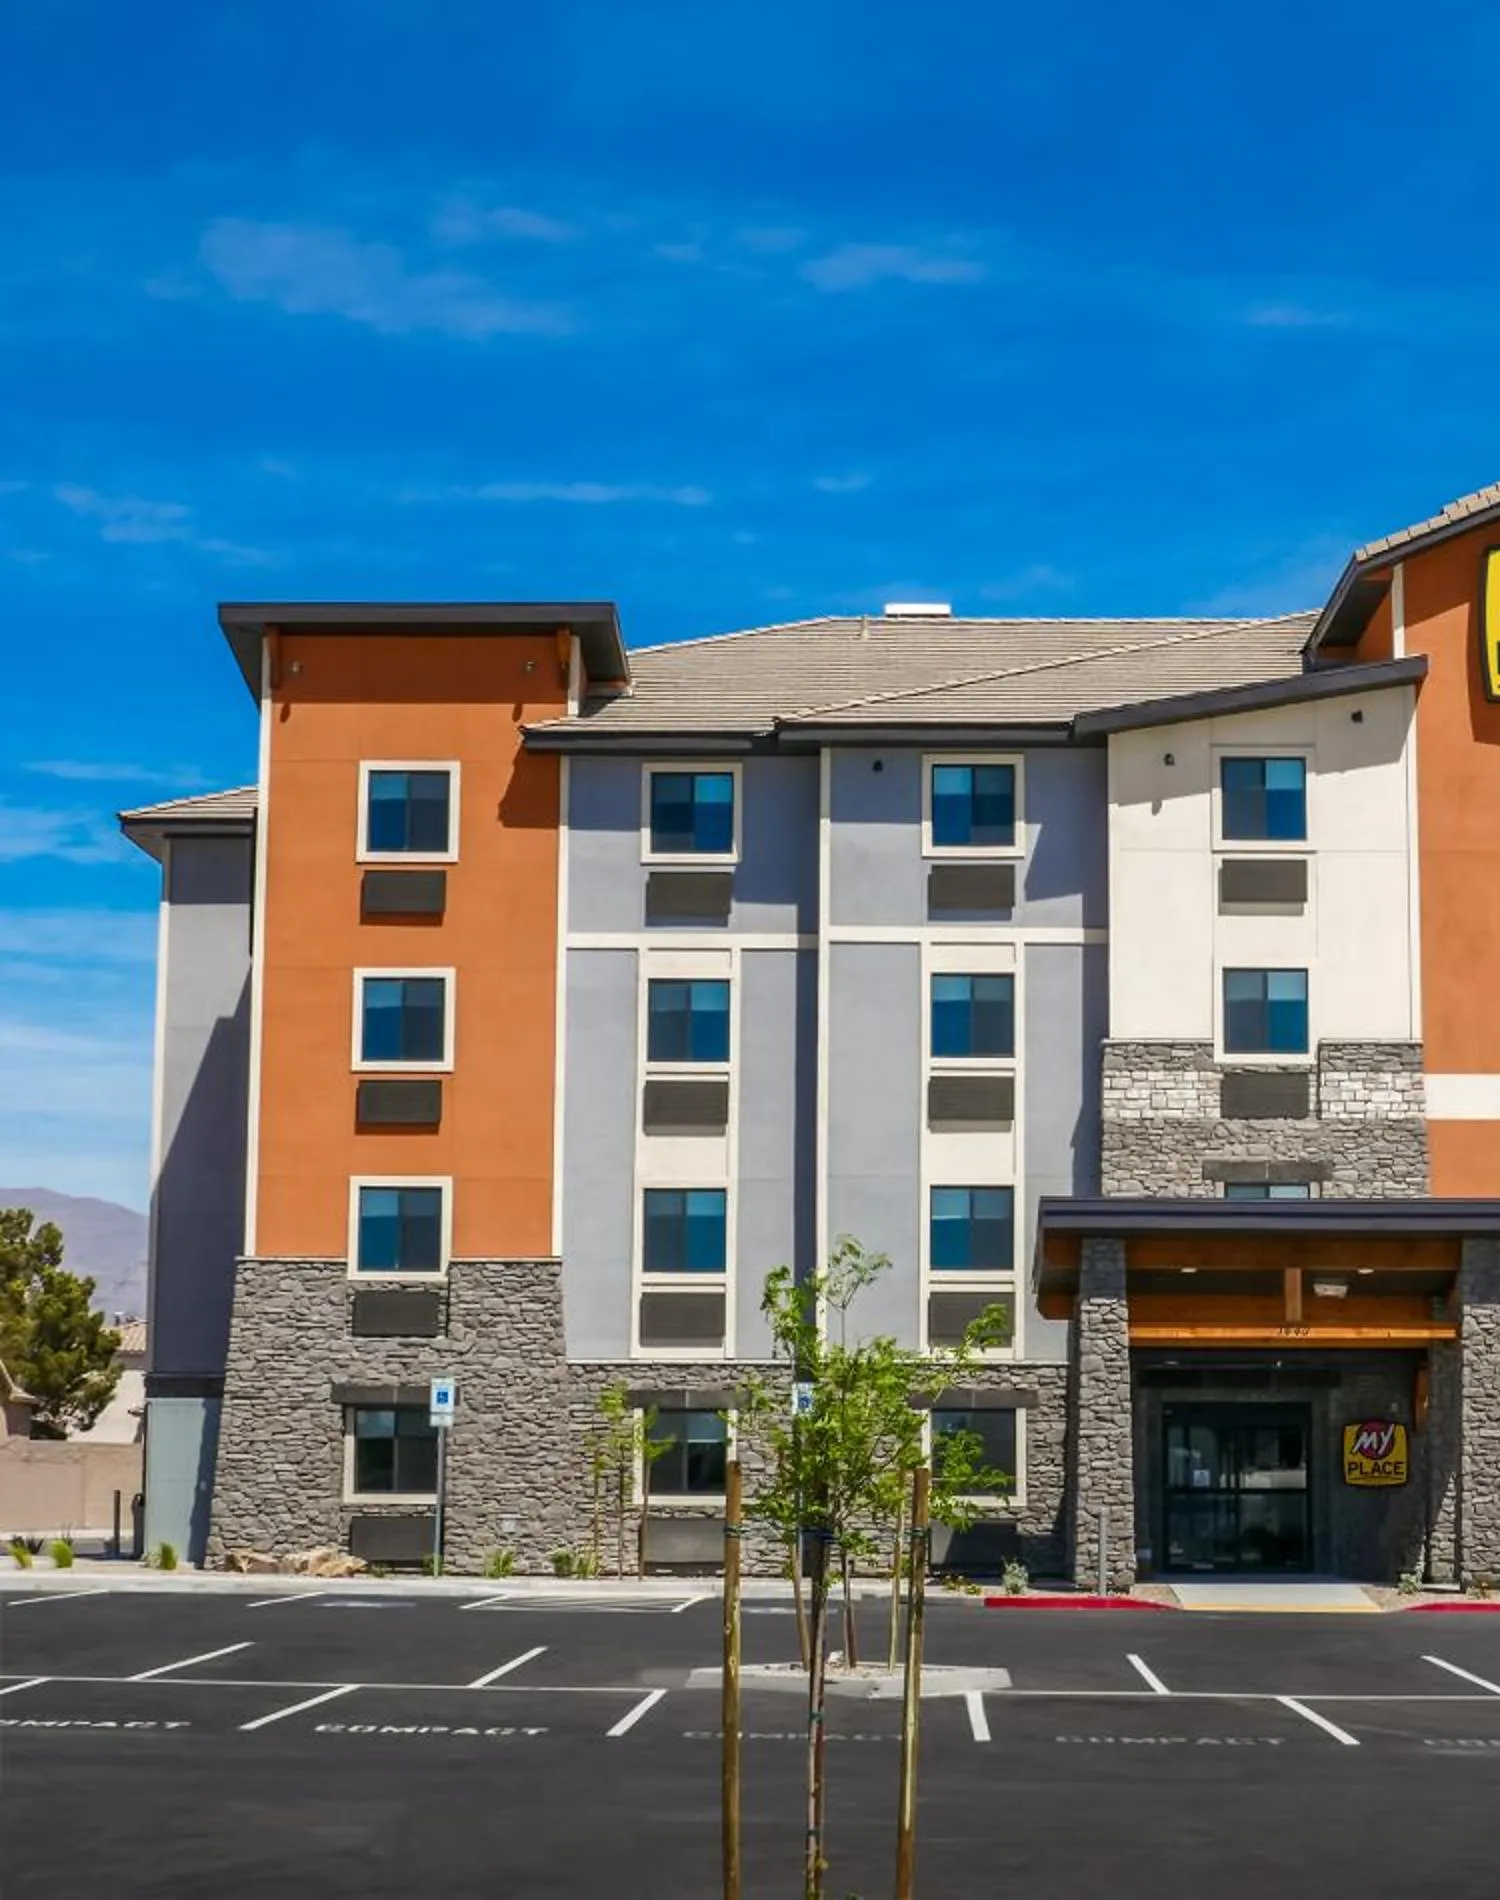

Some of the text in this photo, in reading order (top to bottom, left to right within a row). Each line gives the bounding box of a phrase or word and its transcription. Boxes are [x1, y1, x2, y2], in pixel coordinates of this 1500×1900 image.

[1347, 1461, 1405, 1475] PLACE
[314, 1724, 549, 1735] COMPACT
[1055, 1735, 1286, 1745] COMPACT
